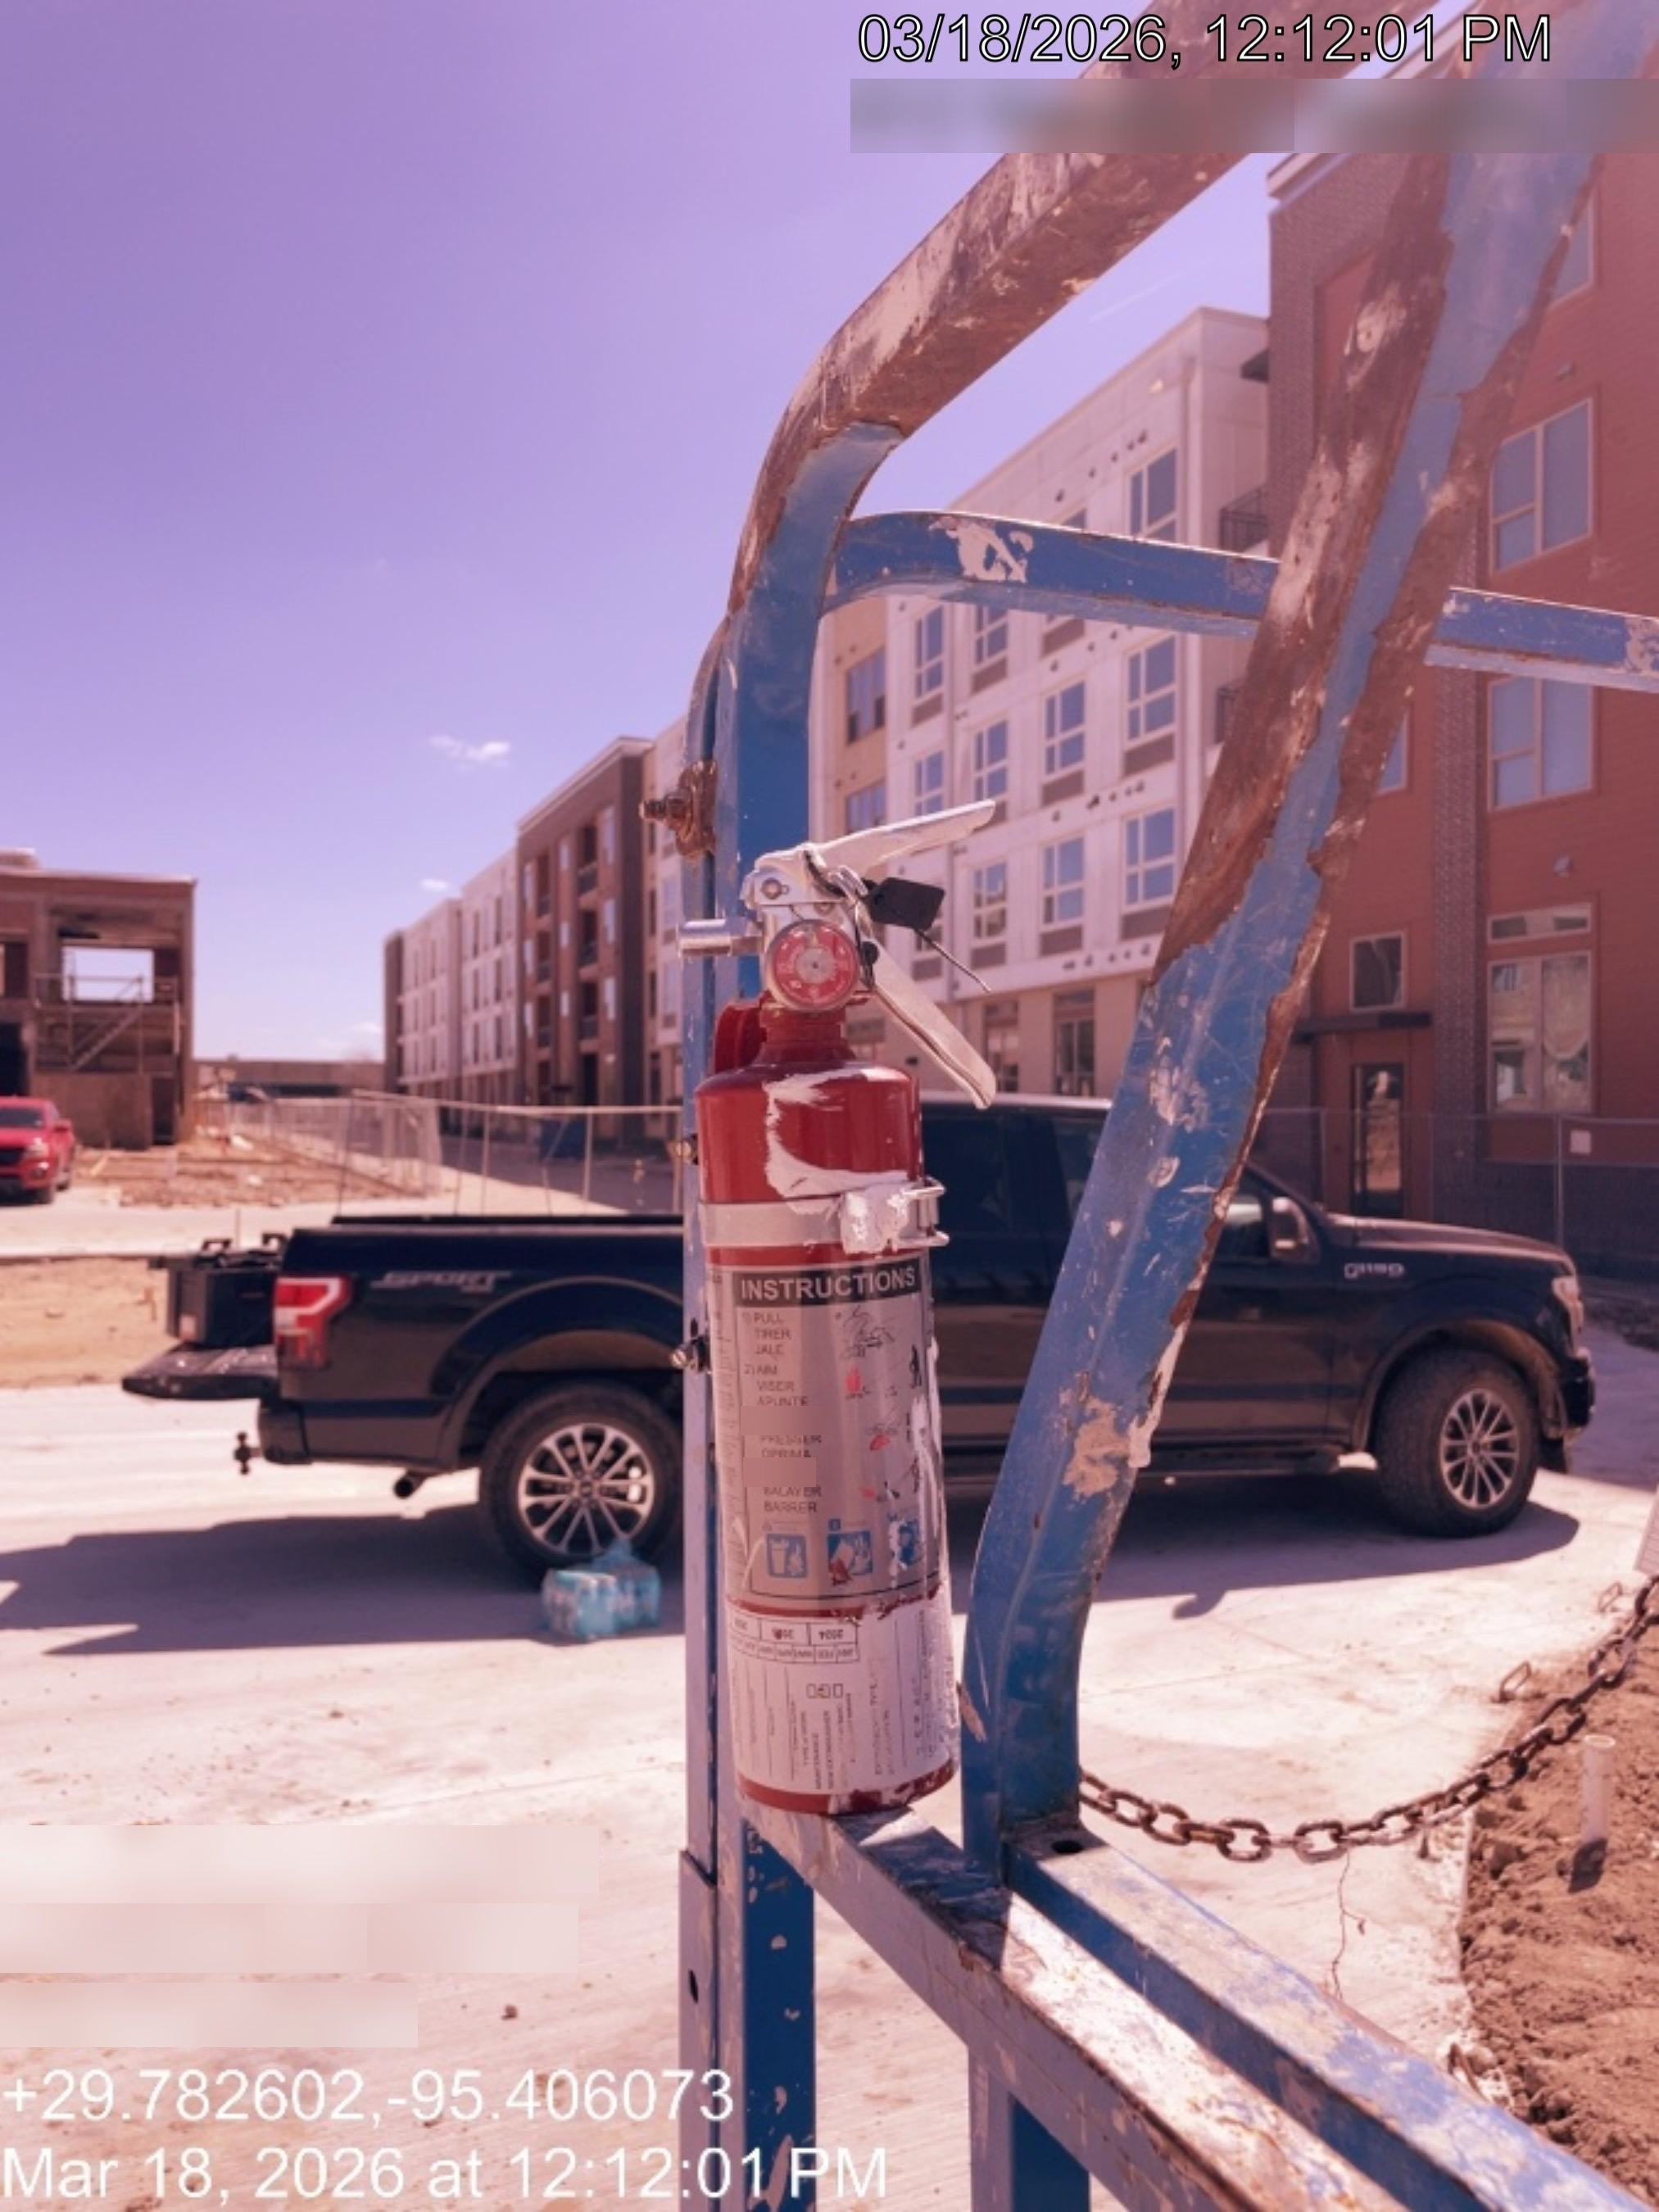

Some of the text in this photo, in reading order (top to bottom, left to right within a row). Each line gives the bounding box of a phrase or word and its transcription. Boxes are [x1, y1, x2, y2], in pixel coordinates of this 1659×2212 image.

[369, 1269, 512, 1292] SPORT
[741, 1265, 915, 1299] INSTRUCTIONS
[754, 1312, 786, 1325] PULL
[754, 1327, 791, 1340] TIRER
[754, 1344, 785, 1355] JALE
[763, 1502, 818, 1513] BARRER
